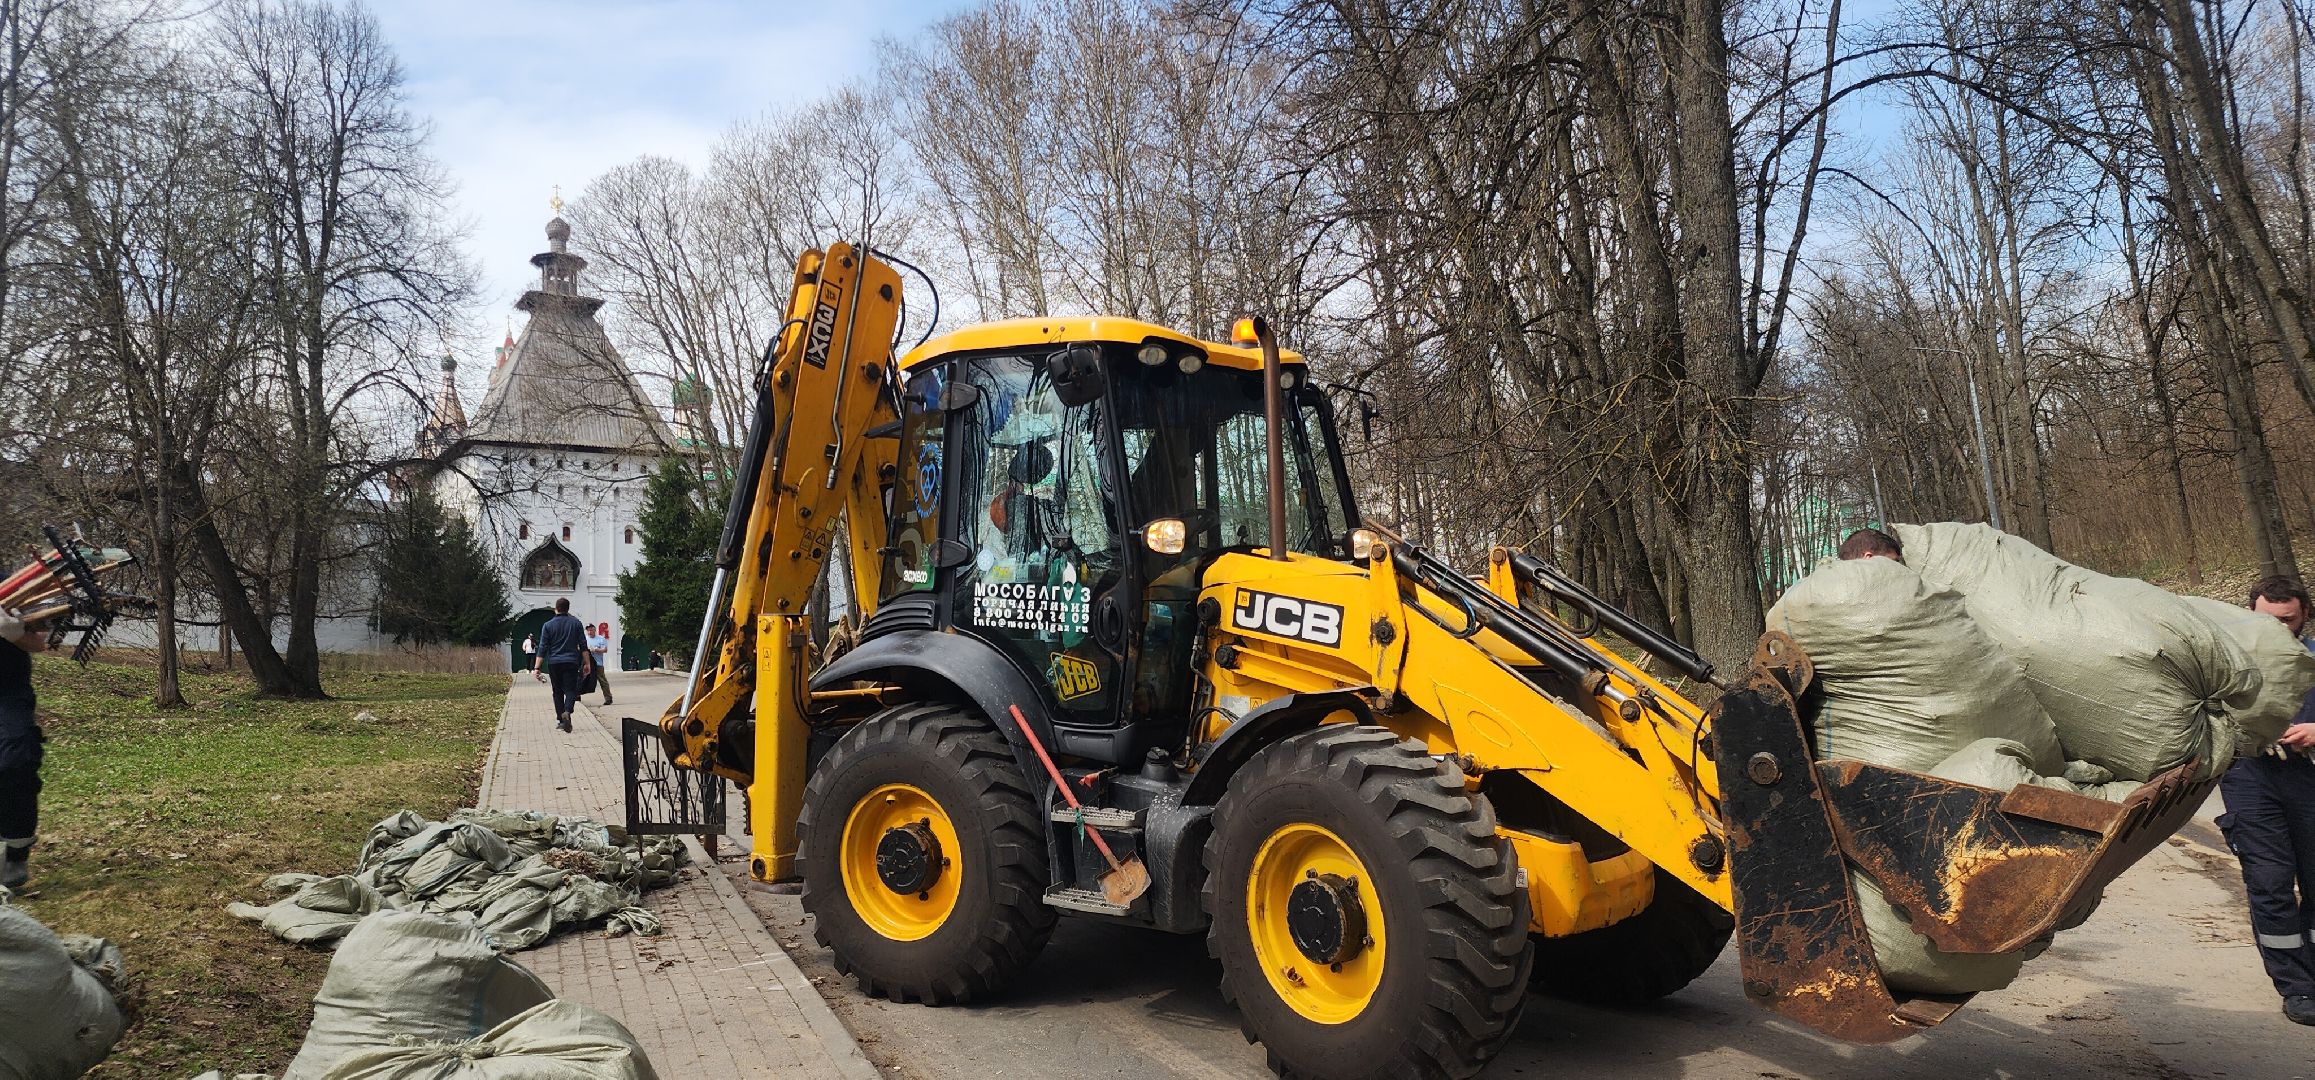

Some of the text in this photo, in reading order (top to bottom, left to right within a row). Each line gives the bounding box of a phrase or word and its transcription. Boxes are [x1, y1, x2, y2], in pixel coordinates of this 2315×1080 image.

[807, 304, 835, 360] 3CX
[973, 606, 981, 617] 8
[986, 608, 1012, 619] 800
[1017, 609, 1044, 621] 200
[1071, 613, 1090, 624] 09
[974, 597, 1035, 610] ГОРЯЧАЯ
[1236, 593, 1340, 644] JCB
[1058, 657, 1098, 696] JCB
